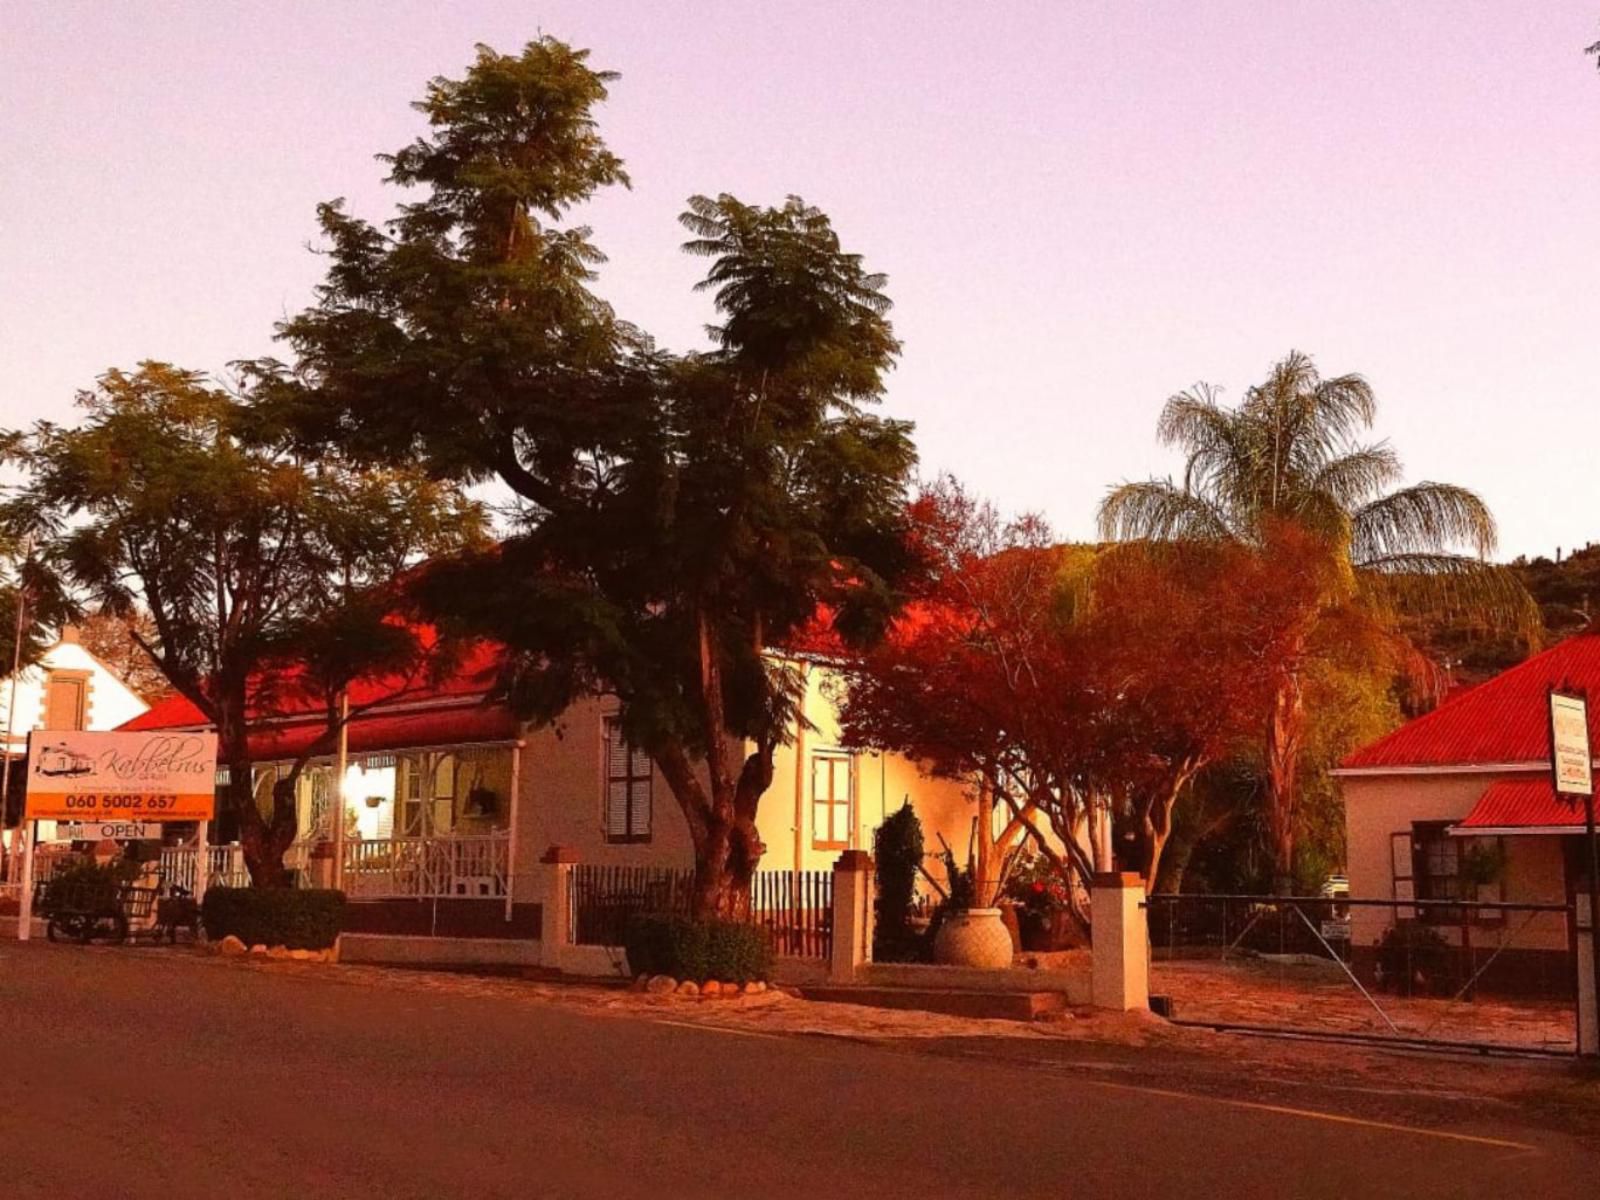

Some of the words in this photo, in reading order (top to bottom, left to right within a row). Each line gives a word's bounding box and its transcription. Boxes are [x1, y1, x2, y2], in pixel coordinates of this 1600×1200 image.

[100, 736, 213, 779] Kabbelrus
[66, 795, 96, 808] 060
[102, 795, 142, 808] 5002
[147, 796, 177, 809] 657
[101, 825, 145, 837] OPEN
